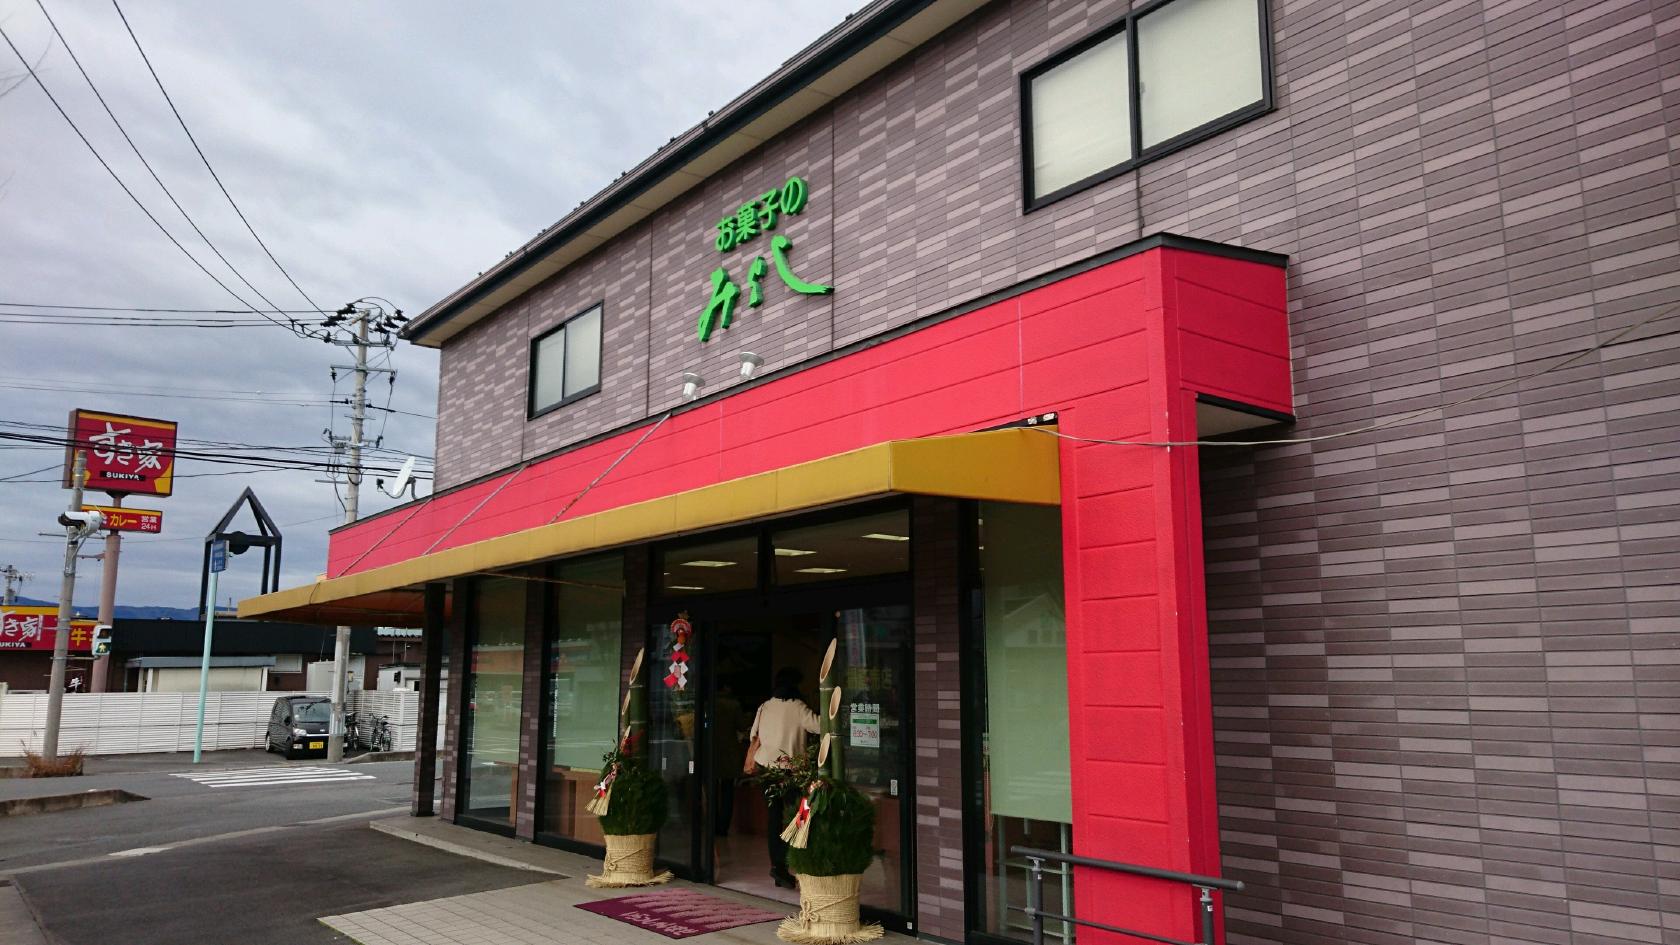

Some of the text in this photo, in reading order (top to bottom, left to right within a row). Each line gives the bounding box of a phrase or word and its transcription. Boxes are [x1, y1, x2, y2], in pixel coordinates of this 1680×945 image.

[717, 176, 808, 252] お菓子の
[89, 422, 163, 473] すき家
[106, 471, 140, 481] SUKIYA
[109, 513, 137, 527] カレー
[850, 702, 880, 713] 営業時間
